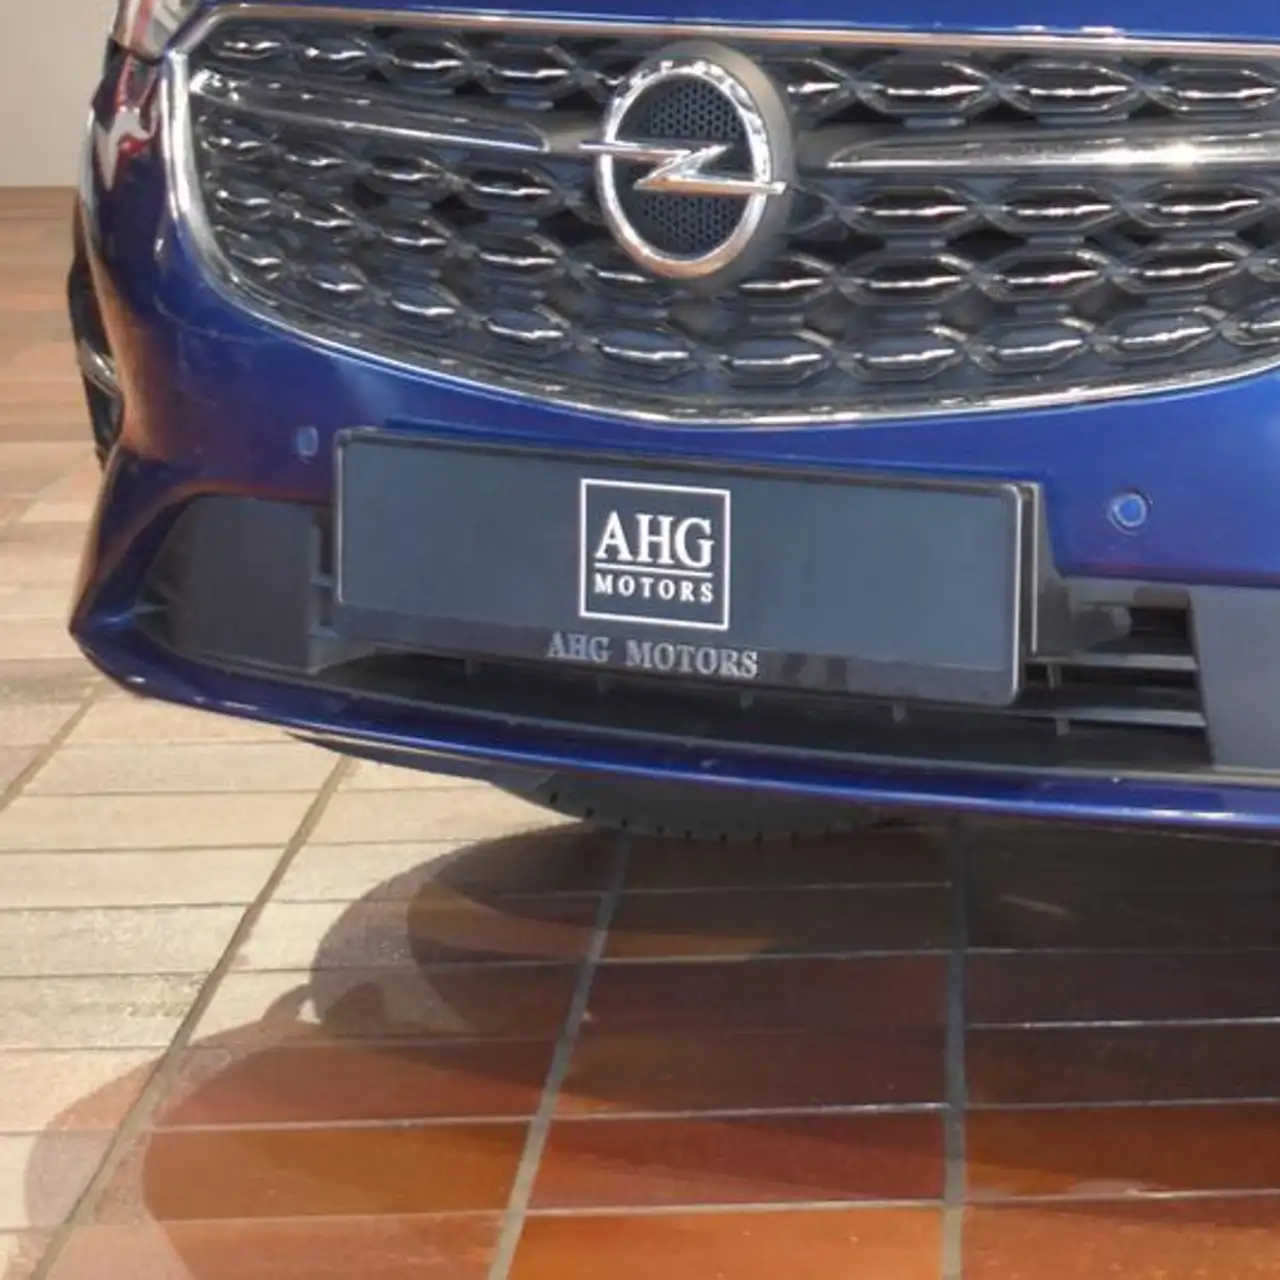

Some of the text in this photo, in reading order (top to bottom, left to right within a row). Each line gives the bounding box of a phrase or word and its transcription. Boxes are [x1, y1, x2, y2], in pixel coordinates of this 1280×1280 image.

[594, 510, 715, 569] AHG
[594, 573, 715, 604] MOTORS
[547, 631, 758, 679] AHG MOTORS
